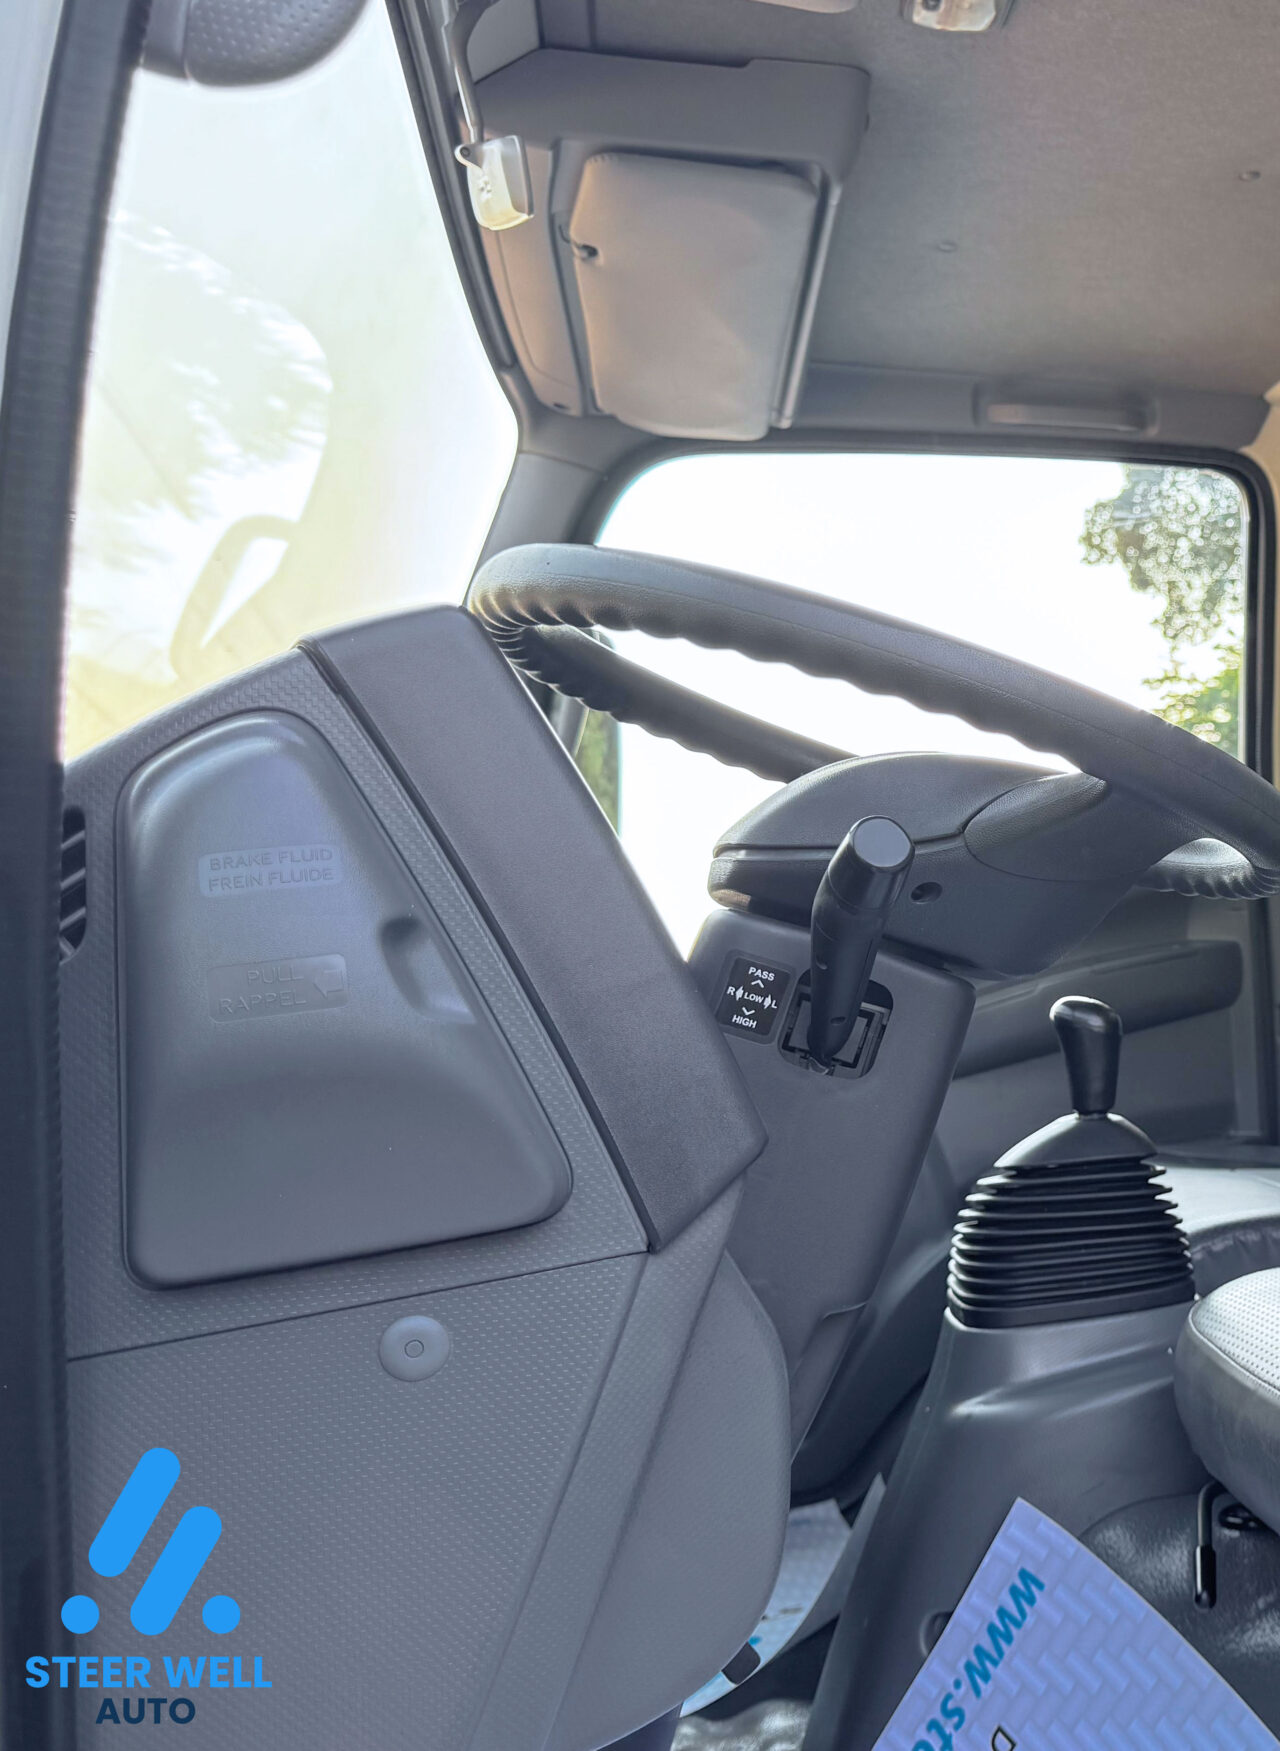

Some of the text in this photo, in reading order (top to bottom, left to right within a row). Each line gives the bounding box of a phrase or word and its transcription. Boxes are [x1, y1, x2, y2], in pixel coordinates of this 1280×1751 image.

[209, 848, 334, 872] BRAKE FLUID
[208, 868, 335, 892] FREIN FLUIDE
[247, 965, 304, 985] PULL
[748, 966, 775, 981] PASS
[220, 989, 307, 1015] RAPPEL
[727, 986, 778, 1009] R LOW L
[732, 1014, 757, 1028] HIGH
